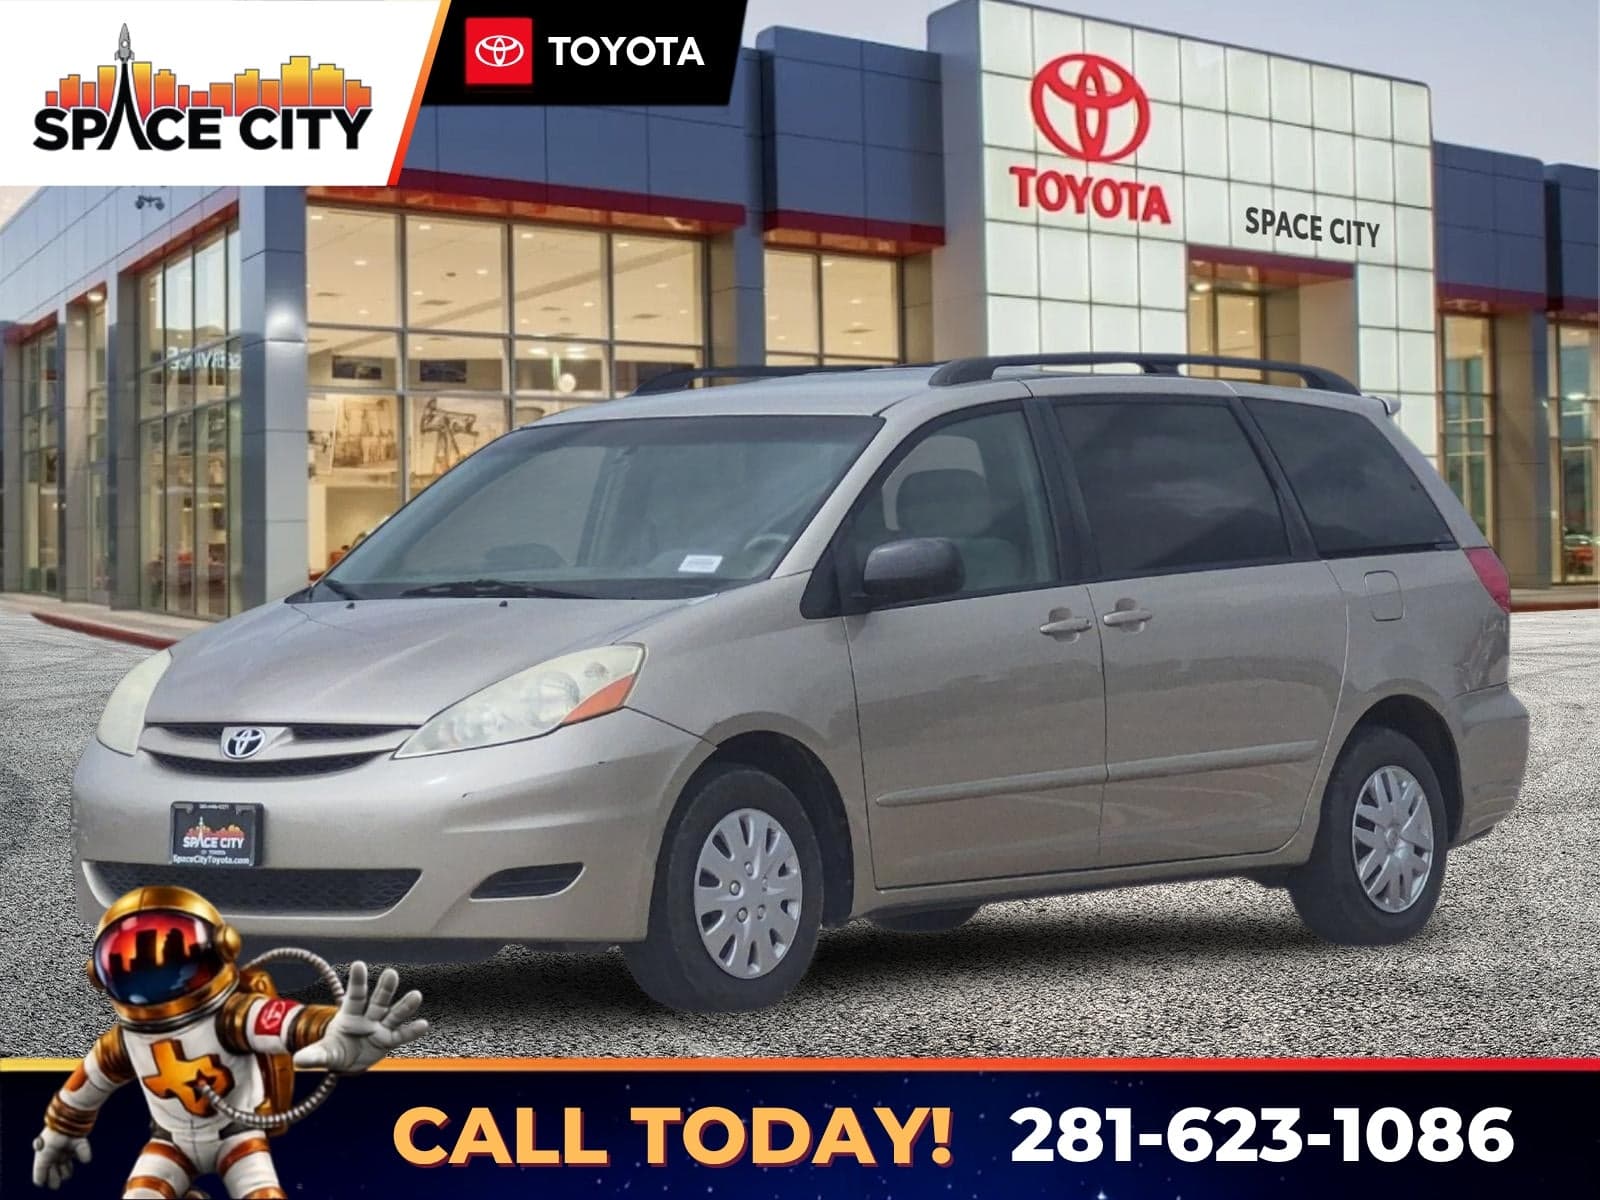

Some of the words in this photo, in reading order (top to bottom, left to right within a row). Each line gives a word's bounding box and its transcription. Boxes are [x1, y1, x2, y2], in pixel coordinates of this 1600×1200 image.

[1009, 166, 1170, 224] TOYOTA
[1246, 206, 1322, 241] SPACE
[1329, 218, 1381, 248] CITY
[183, 836, 218, 848] SPACE
[220, 837, 244, 849] CITY
[173, 854, 250, 865] SpaceCityToyota.com
